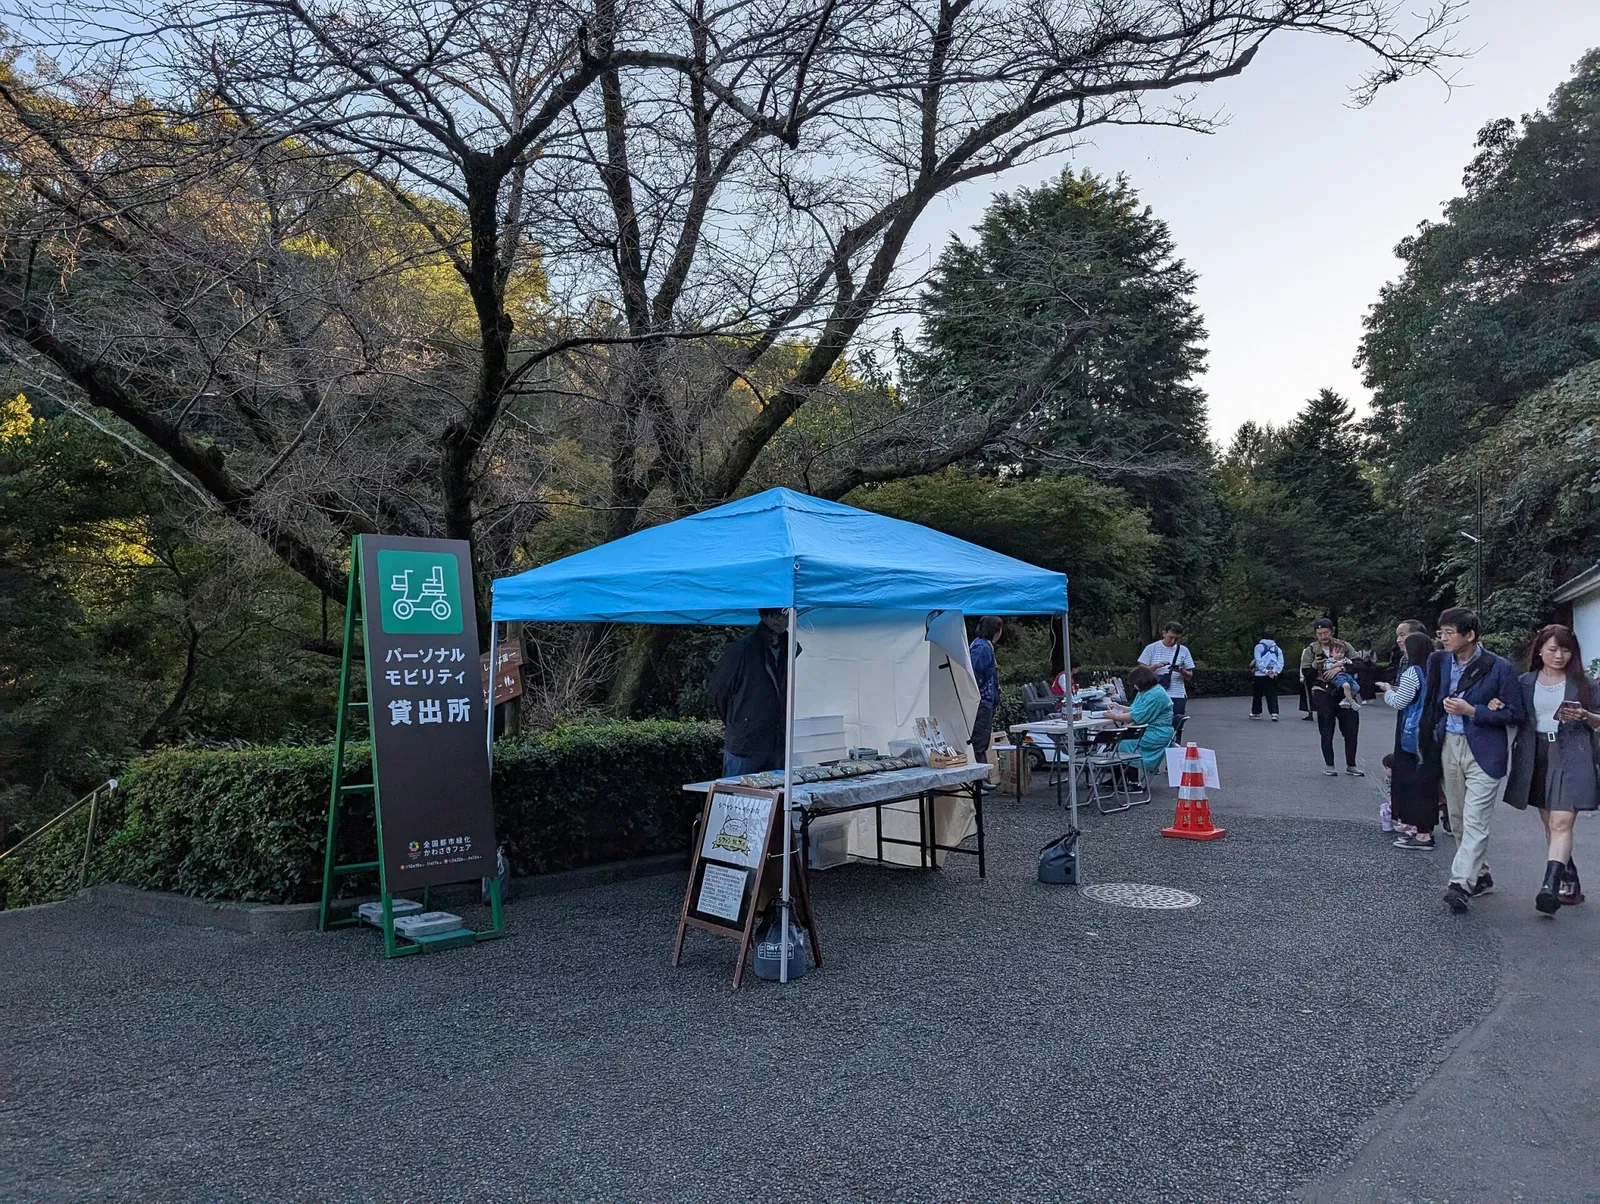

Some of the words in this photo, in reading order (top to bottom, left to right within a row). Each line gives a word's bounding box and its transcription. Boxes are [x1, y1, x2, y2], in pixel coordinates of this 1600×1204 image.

[385, 647, 465, 664] パーソナル
[385, 668, 465, 686] モビリティ
[387, 697, 471, 726] 貸出所
[423, 836, 472, 849] 全国都市緑化
[423, 844, 472, 857] かわさきフェア
